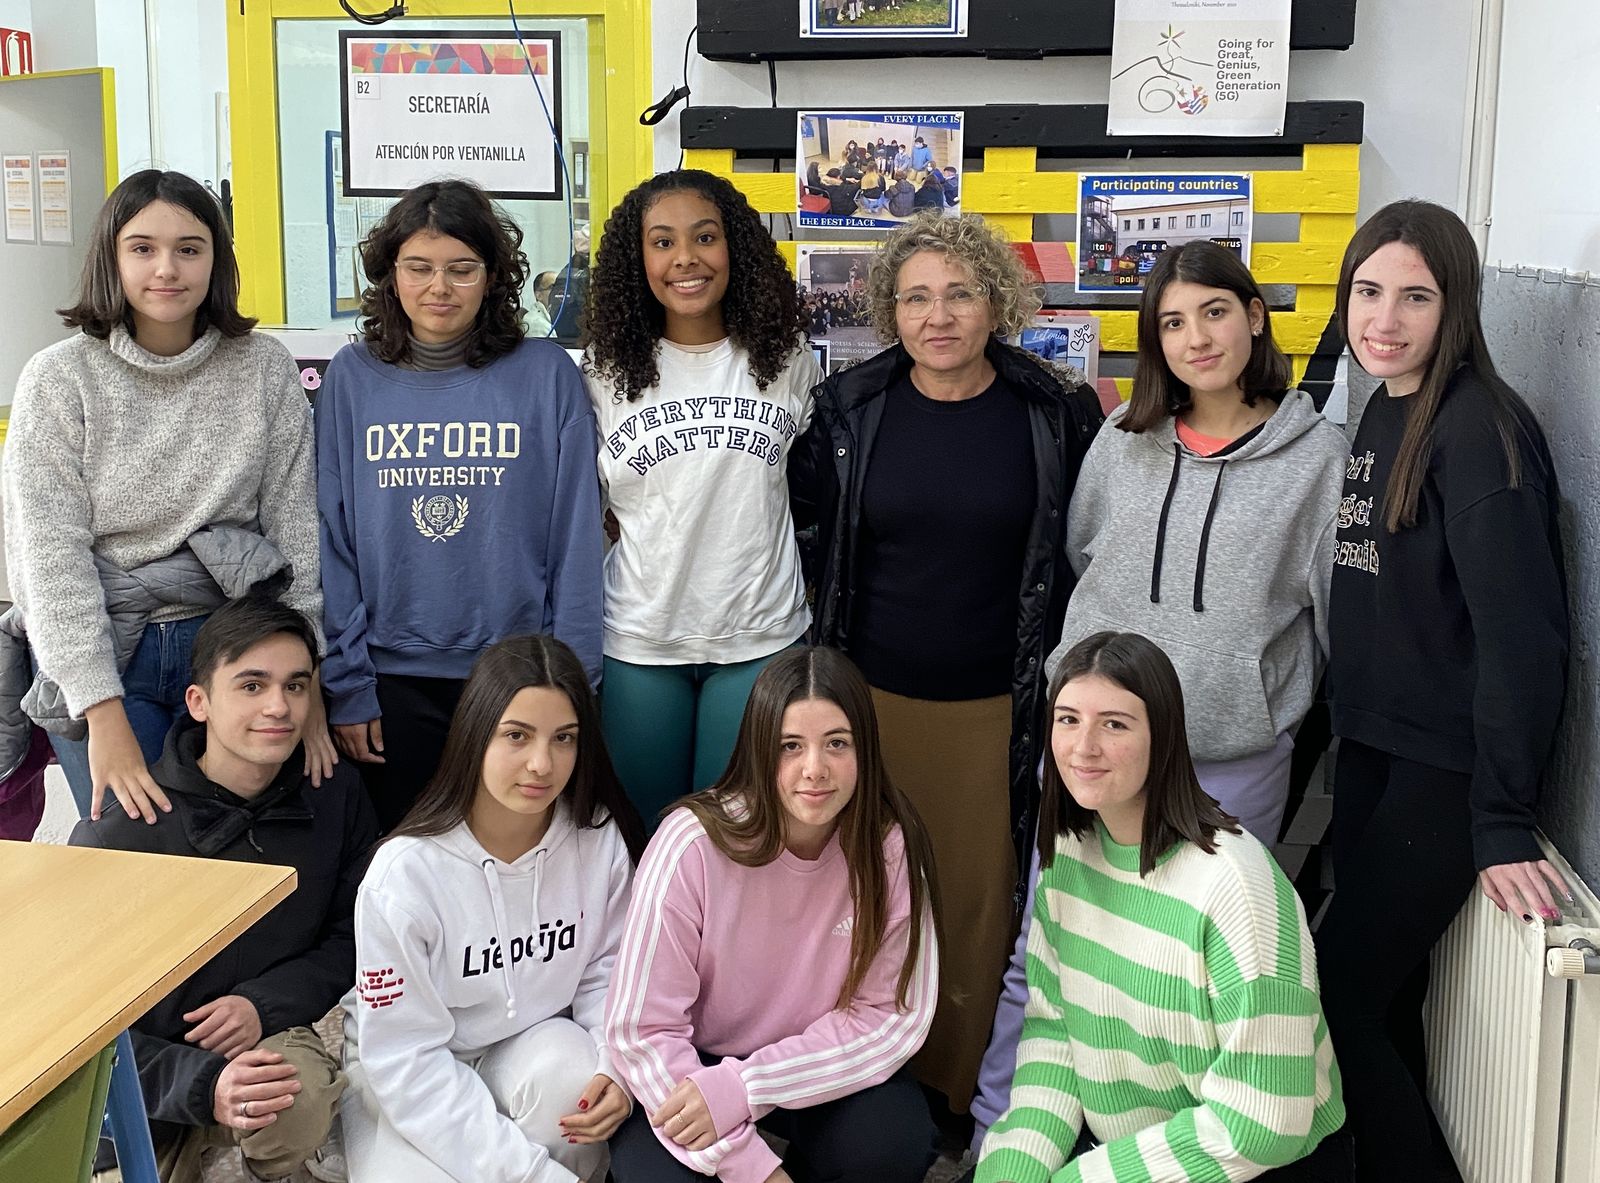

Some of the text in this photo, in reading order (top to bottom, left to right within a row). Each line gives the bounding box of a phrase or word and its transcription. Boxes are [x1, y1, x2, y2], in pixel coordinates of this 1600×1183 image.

[1218, 38, 1274, 50] Going for
[1217, 49, 1254, 60] Great,
[1217, 60, 1260, 71] Genius,
[1216, 70, 1251, 80] Green
[357, 81, 370, 94] B2
[1215, 80, 1281, 90] Generation
[1215, 91, 1239, 102] (5G)
[408, 93, 490, 115] SECRETARÍA
[883, 115, 915, 124] EVERY
[917, 115, 948, 124] PLACE
[950, 115, 960, 124] IS
[375, 142, 526, 163] ATENCIÓN POR VENTANILLA
[1092, 179, 1239, 192] Participating countries
[800, 217, 876, 227] THE BEST PLACE
[1092, 242, 1114, 253] Italy
[1210, 239, 1241, 249] prus
[1114, 274, 1140, 285] Spain
[366, 421, 521, 462] OXFORD
[627, 425, 781, 476] MATTERS
[377, 466, 506, 488] UNIVERSITY
